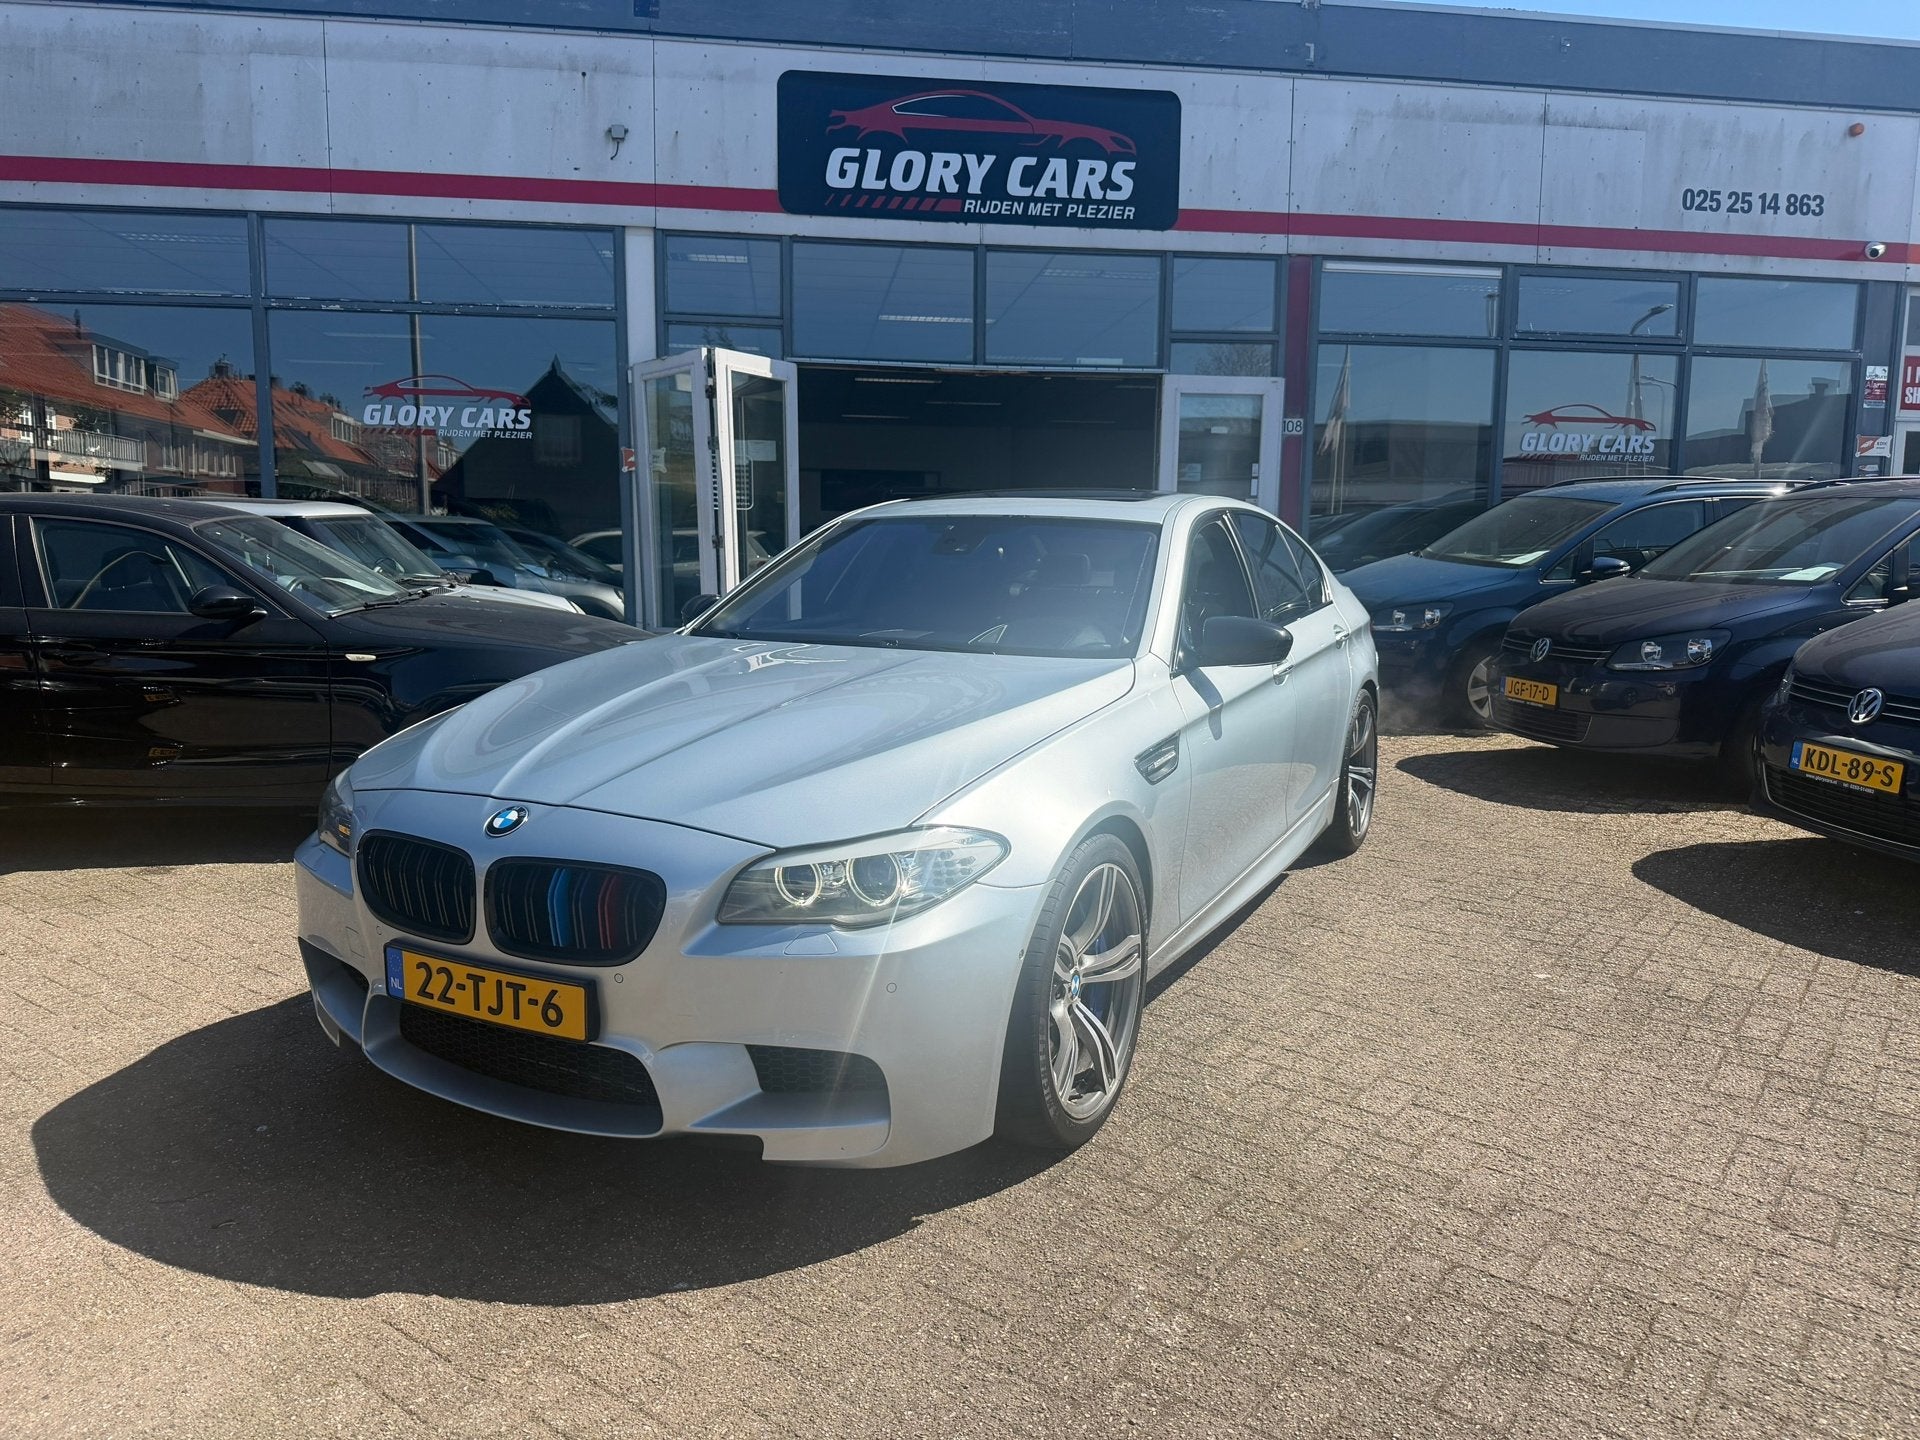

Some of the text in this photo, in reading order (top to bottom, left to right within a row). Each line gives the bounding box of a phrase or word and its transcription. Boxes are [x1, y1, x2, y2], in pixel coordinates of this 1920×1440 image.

[825, 147, 1137, 201] GLORY CARS
[964, 199, 1136, 220] RIJDEN MET PLEZIER
[1682, 188, 1824, 217] 025 25 14 863
[363, 404, 532, 430] GLORY CARS
[1283, 420, 1303, 433] 108
[438, 429, 533, 440] RIJDEN MET PLEZIER
[1521, 432, 1656, 454] GLORY CARS
[1579, 454, 1606, 462] RIJDEN
[1624, 455, 1655, 463] PLEZIER
[1508, 680, 1549, 701] JGF-17-D
[1804, 747, 1895, 787] KDL-89-S
[390, 977, 403, 990] NL
[415, 961, 564, 1028] 22-TJT-6
